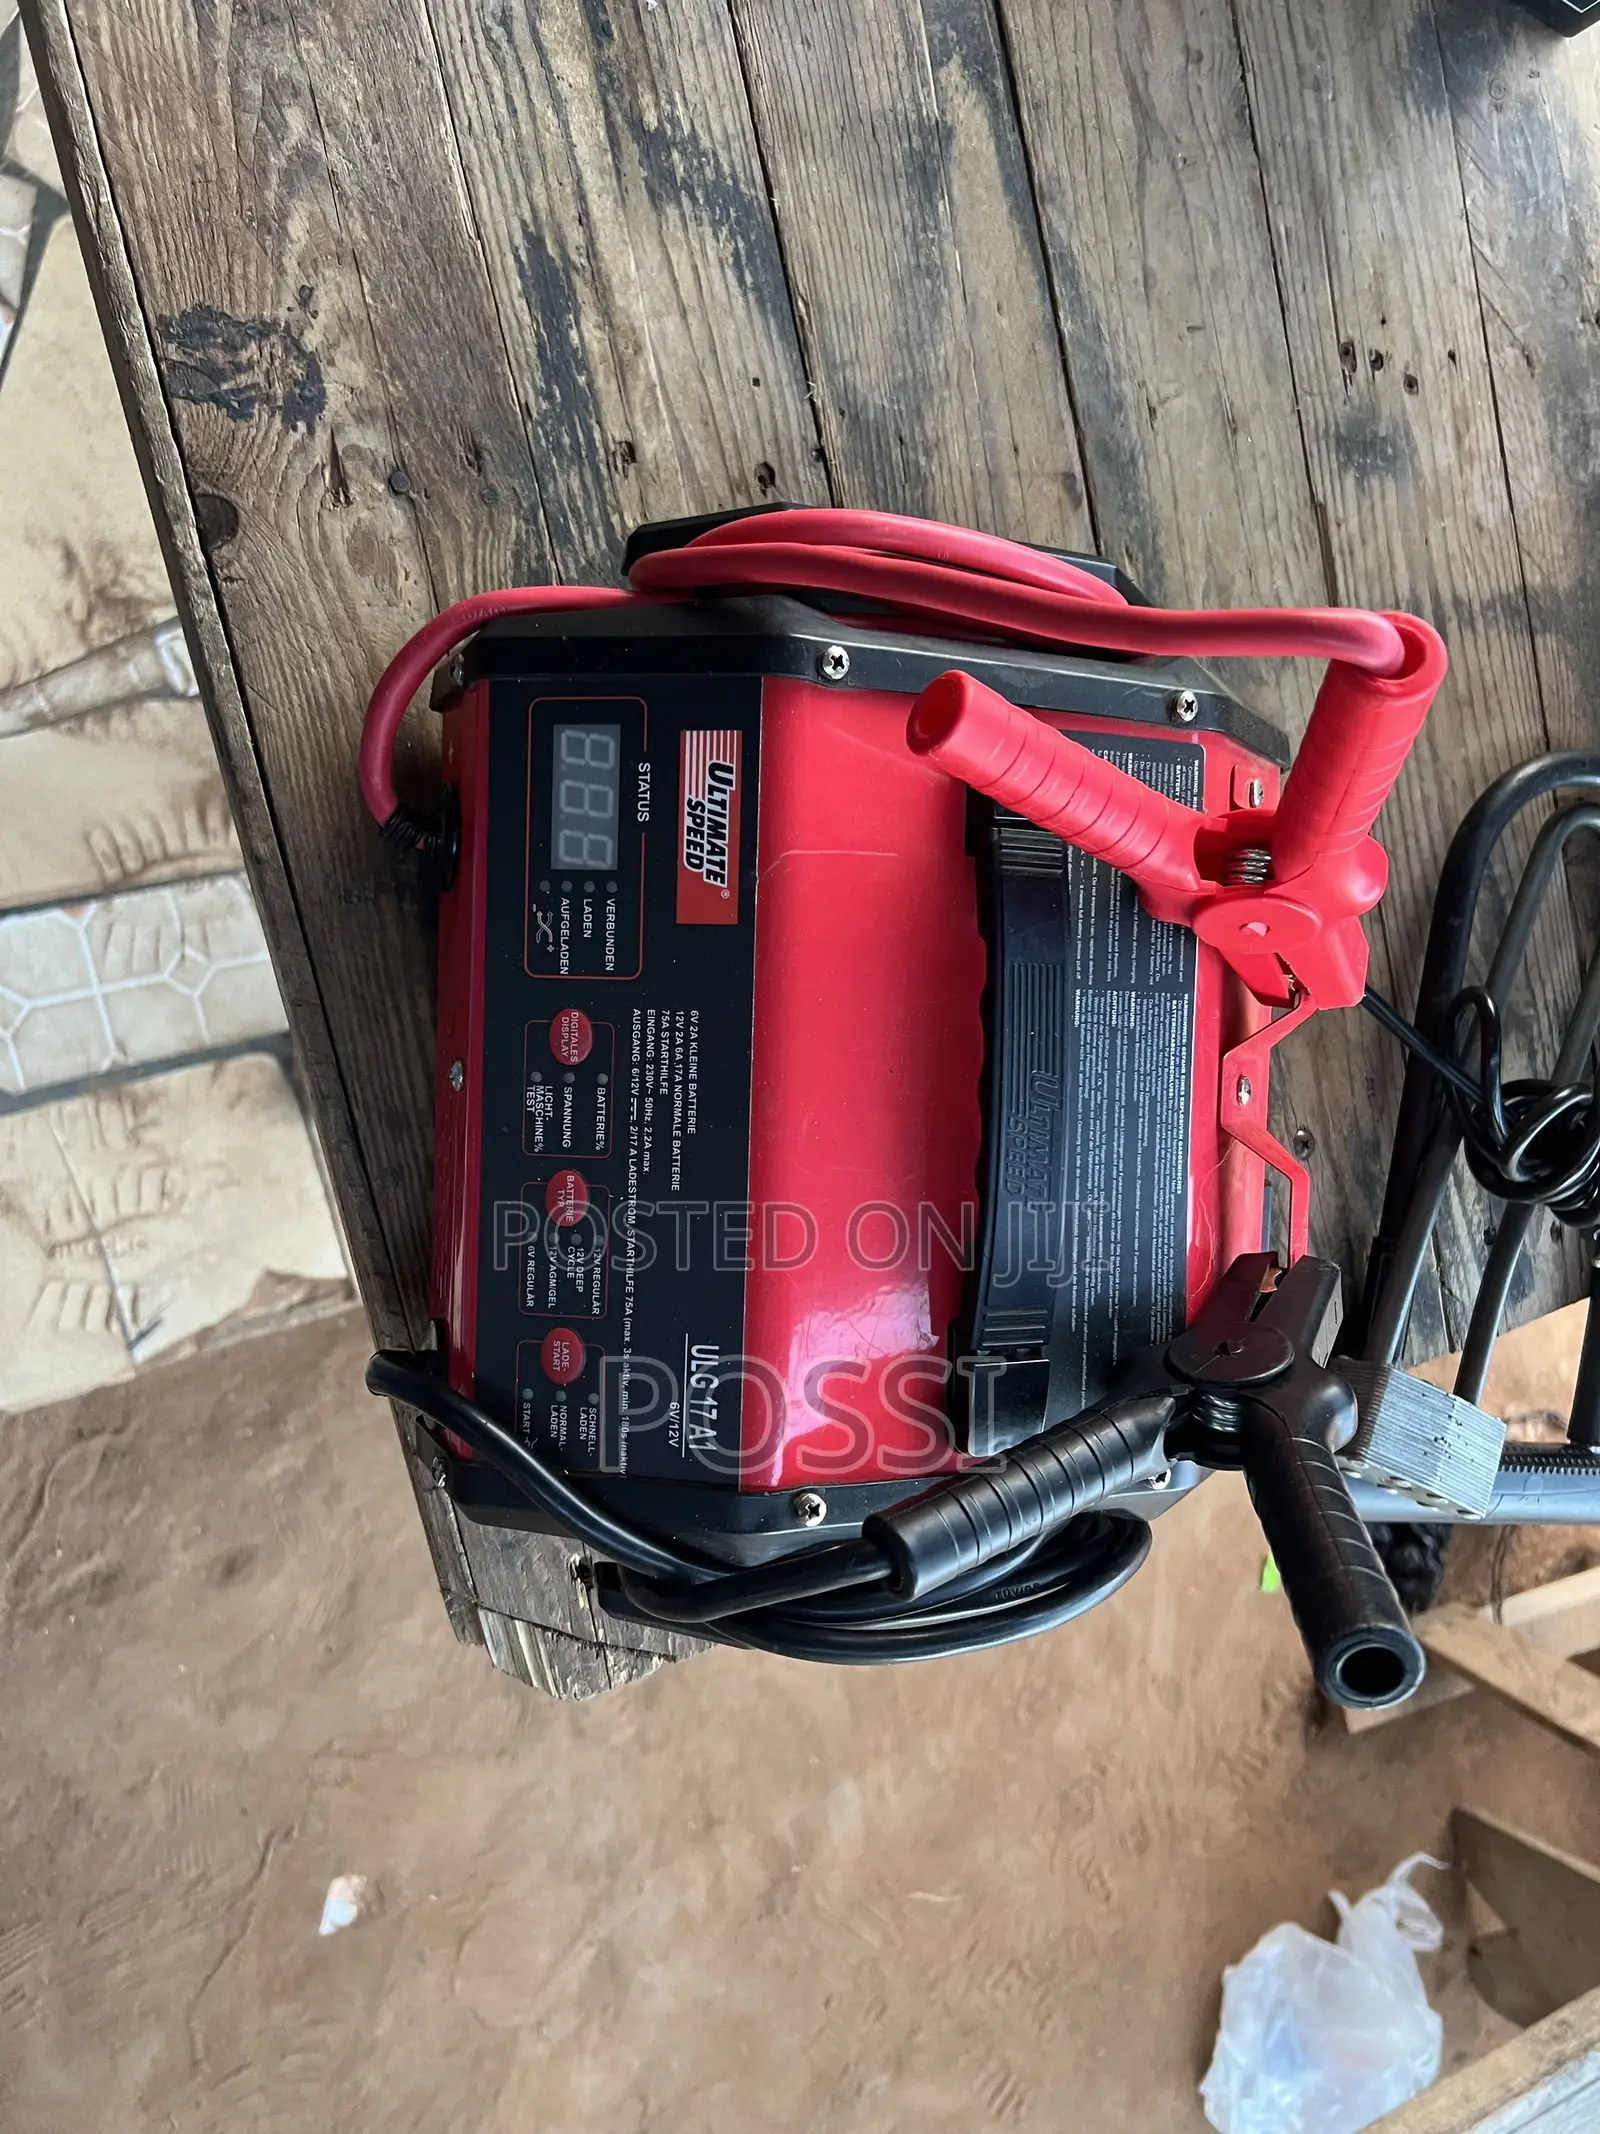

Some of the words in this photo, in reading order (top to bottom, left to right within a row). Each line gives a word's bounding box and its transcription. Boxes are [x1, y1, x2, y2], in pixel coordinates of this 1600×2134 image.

[637, 762, 650, 822] STATUS
[685, 797, 705, 870] SPEED
[706, 762, 734, 885] ULTIMATE
[583, 899, 592, 937] LADEN
[559, 897, 570, 974] AUFGELADEN
[605, 899, 616, 971] VERBUNDEN
[661, 1010, 670, 1029] 75A
[676, 1010, 684, 1029] 12V
[689, 1026, 698, 1039] 2A
[690, 1010, 698, 1023] 6V
[561, 1017, 569, 1057] DISPLAY
[570, 1012, 578, 1062] DIGITALES
[631, 1009, 641, 1065] AUSGANG:
[646, 1009, 655, 1061] EINGANG:
[675, 1031, 683, 1044] 2A
[659, 1031, 669, 1095] STARTHILFE
[674, 1047, 683, 1060] 6A
[688, 1042, 697, 1080] KLEINE
[630, 1068, 640, 1095] 6/12V
[526, 1085, 535, 1112] TEST
[544, 1086, 553, 1120] LICHT-
[643, 1097, 653, 1124] 50Hz,
[672, 1084, 682, 1137] NORMALE
[687, 1083, 696, 1134] BATTERIE
[534, 1085, 544, 1152] MASCHINE%
[562, 1087, 572, 1148] SPANNUNG
[595, 1087, 606, 1150] BATTERIE%
[629, 1126, 639, 1146] 2/17
[643, 1151, 651, 1175] max.
[671, 1140, 681, 1191] BATTERIE
[1005, 1116, 1028, 1196] SPEED
[557, 1189, 565, 1207] TYP
[565, 1175, 574, 1222] BATTERIE
[626, 1159, 637, 1226] LADESTROM,
[526, 1245, 535, 1258] 6V
[548, 1246, 557, 1263] 12V
[567, 1246, 576, 1278] CYCLE
[576, 1247, 585, 1264] 12V
[592, 1248, 602, 1265] 12V
[624, 1229, 636, 1293] STARTHILFE
[525, 1260, 535, 1307] REGULÄR
[547, 1265, 557, 1309] AGM/GEL
[576, 1266, 584, 1292] DEEP
[591, 1267, 601, 1315] REGULÄR
[624, 1296, 634, 1316] 75A
[622, 1318, 634, 1345] (max.
[552, 1341, 561, 1371] START
[561, 1342, 570, 1371] LADE-
[622, 1347, 632, 1359] 3s
[690, 1344, 719, 1389] ULG
[620, 1362, 632, 1388] aktiv,
[522, 1402, 531, 1433] START
[621, 1391, 631, 1412] min.
[689, 1396, 718, 1420] 17
[550, 1405, 559, 1438] LADEN
[558, 1405, 567, 1451] NORMAL-
[579, 1407, 587, 1440] LADEN
[587, 1408, 597, 1457] SCHNELL-
[620, 1416, 631, 1438] 180s
[667, 1402, 680, 1447] 6V/12V
[688, 1423, 717, 1451] A1
